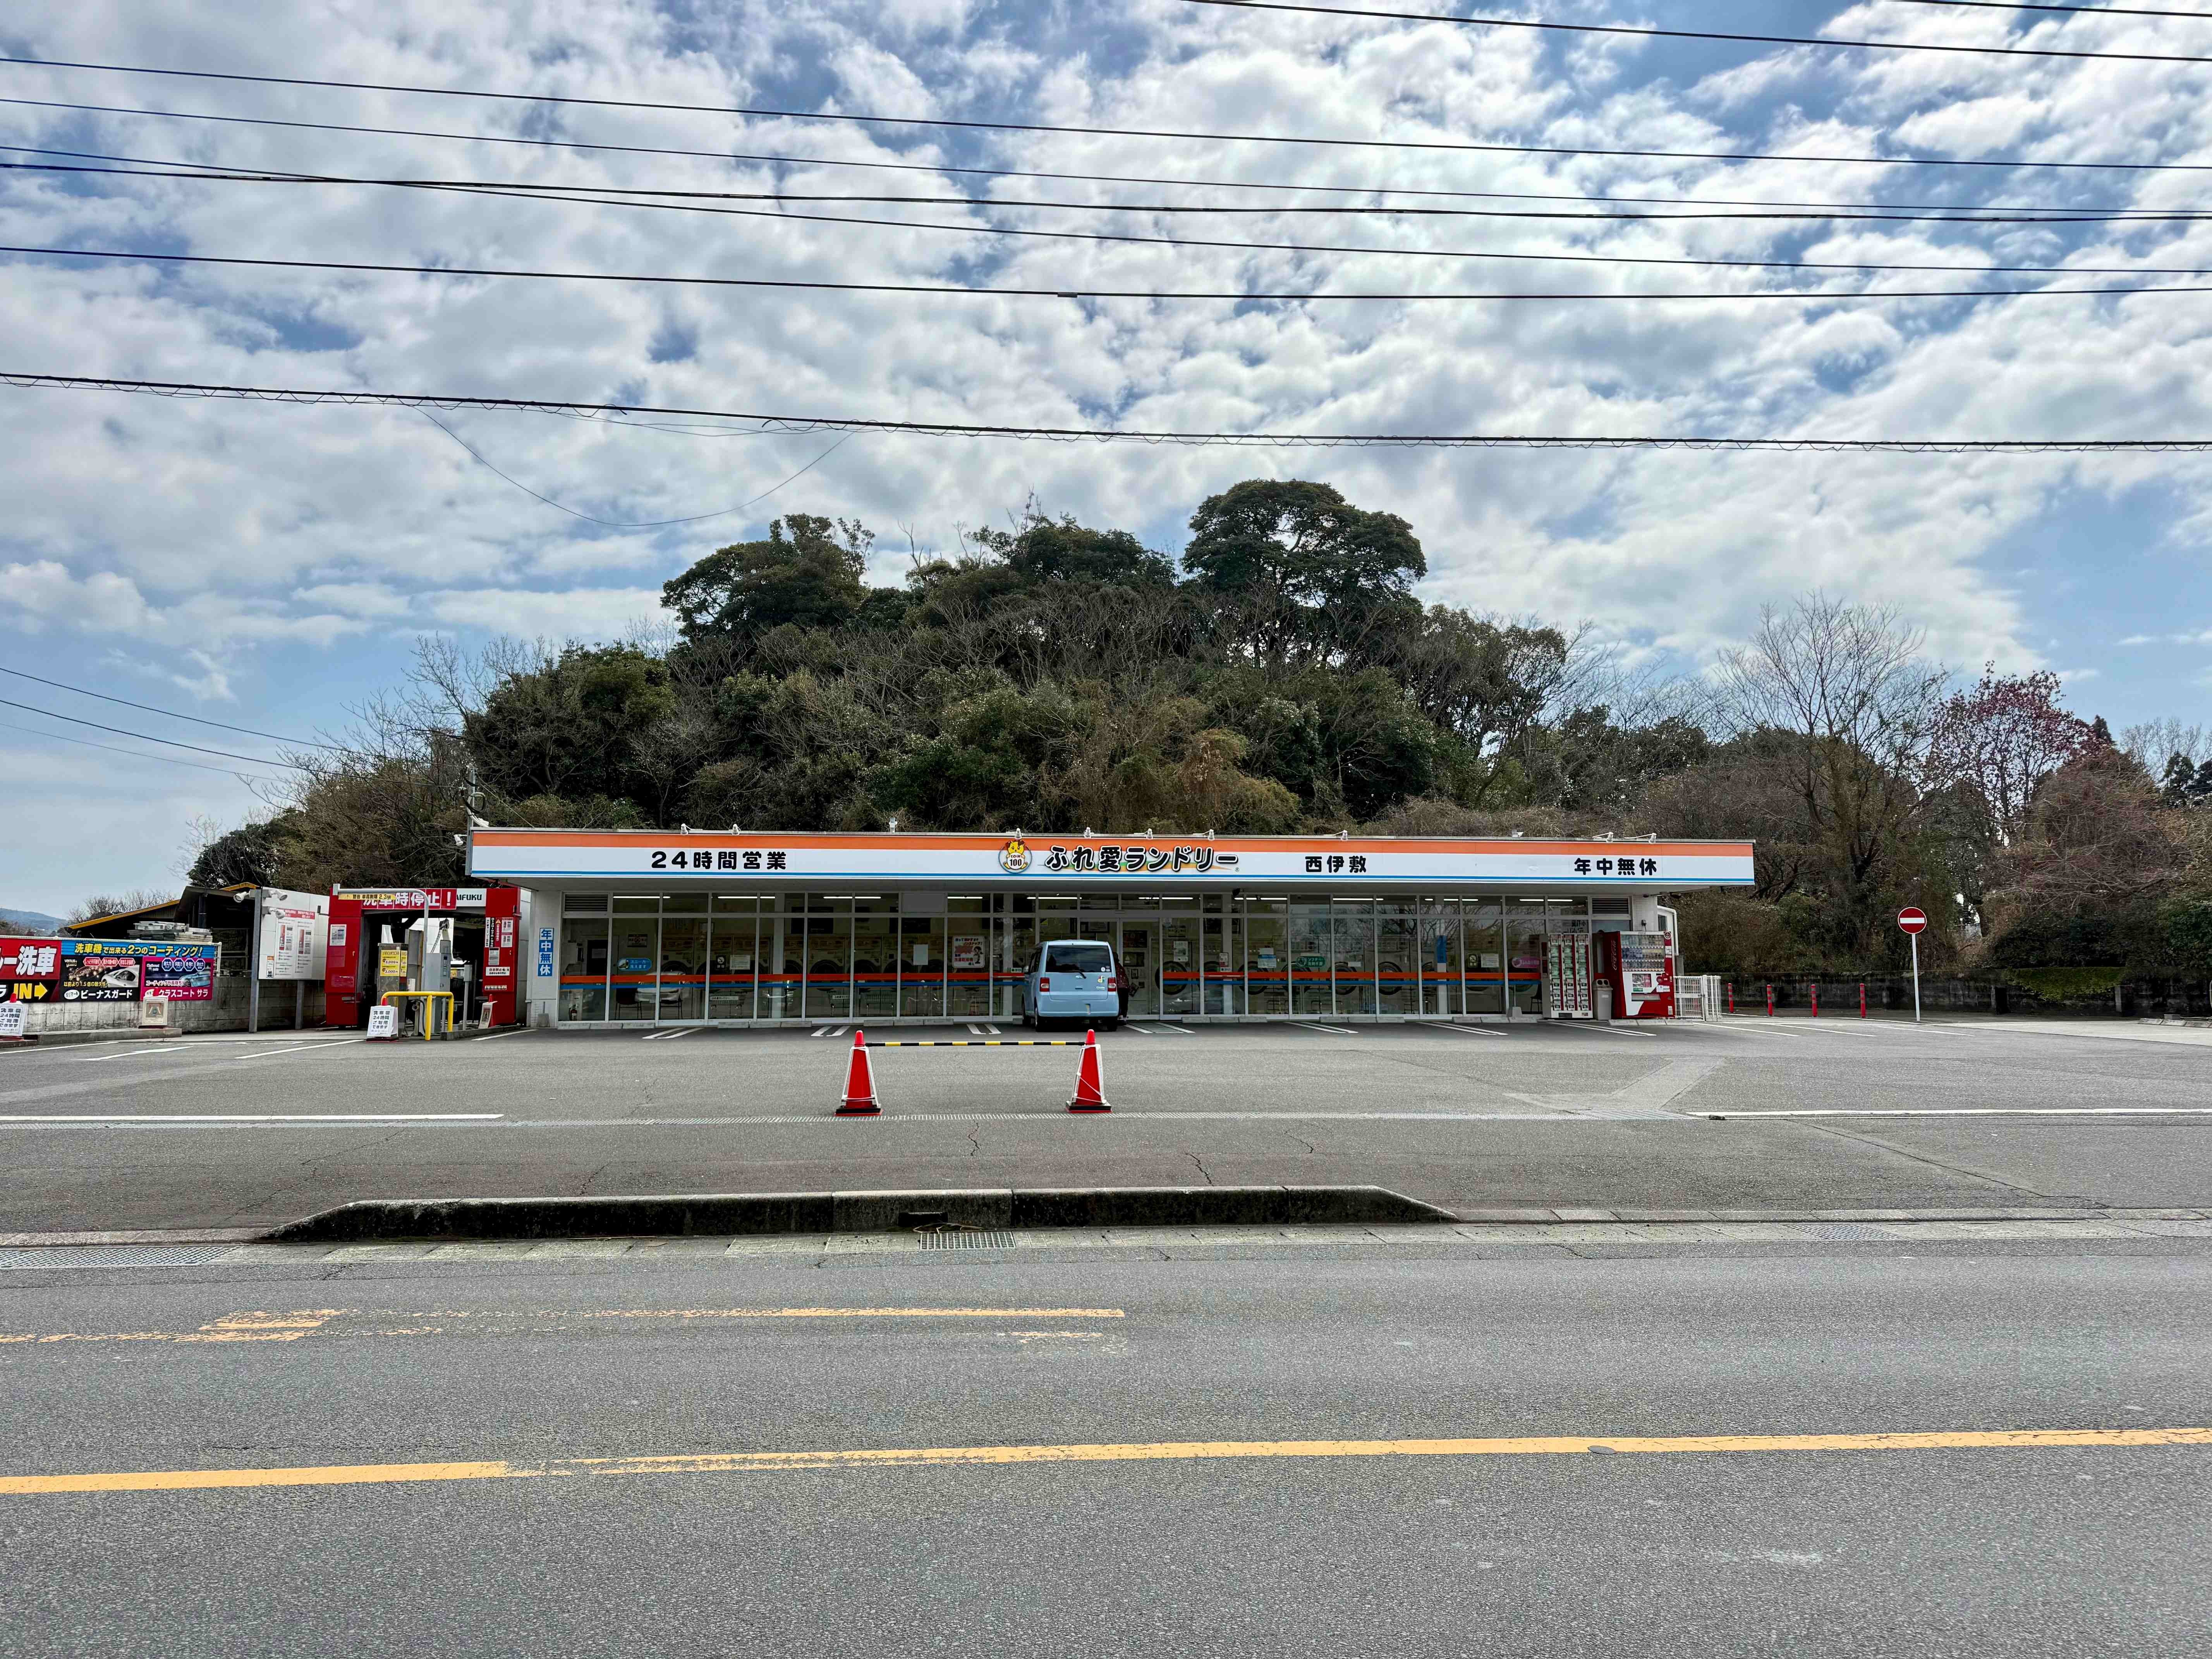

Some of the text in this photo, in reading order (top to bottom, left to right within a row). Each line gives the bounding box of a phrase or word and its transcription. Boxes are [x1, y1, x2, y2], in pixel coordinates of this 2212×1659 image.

[651, 851, 787, 870] 24時間営業
[1045, 845, 1238, 872] ふれ愛ランドリー
[1305, 855, 1367, 873] 西伊敷
[1574, 858, 1657, 876] 年中無休
[540, 929, 552, 975] 年中無休
[81, 989, 132, 999] ビーナスガード
[197, 989, 208, 997] サラ
